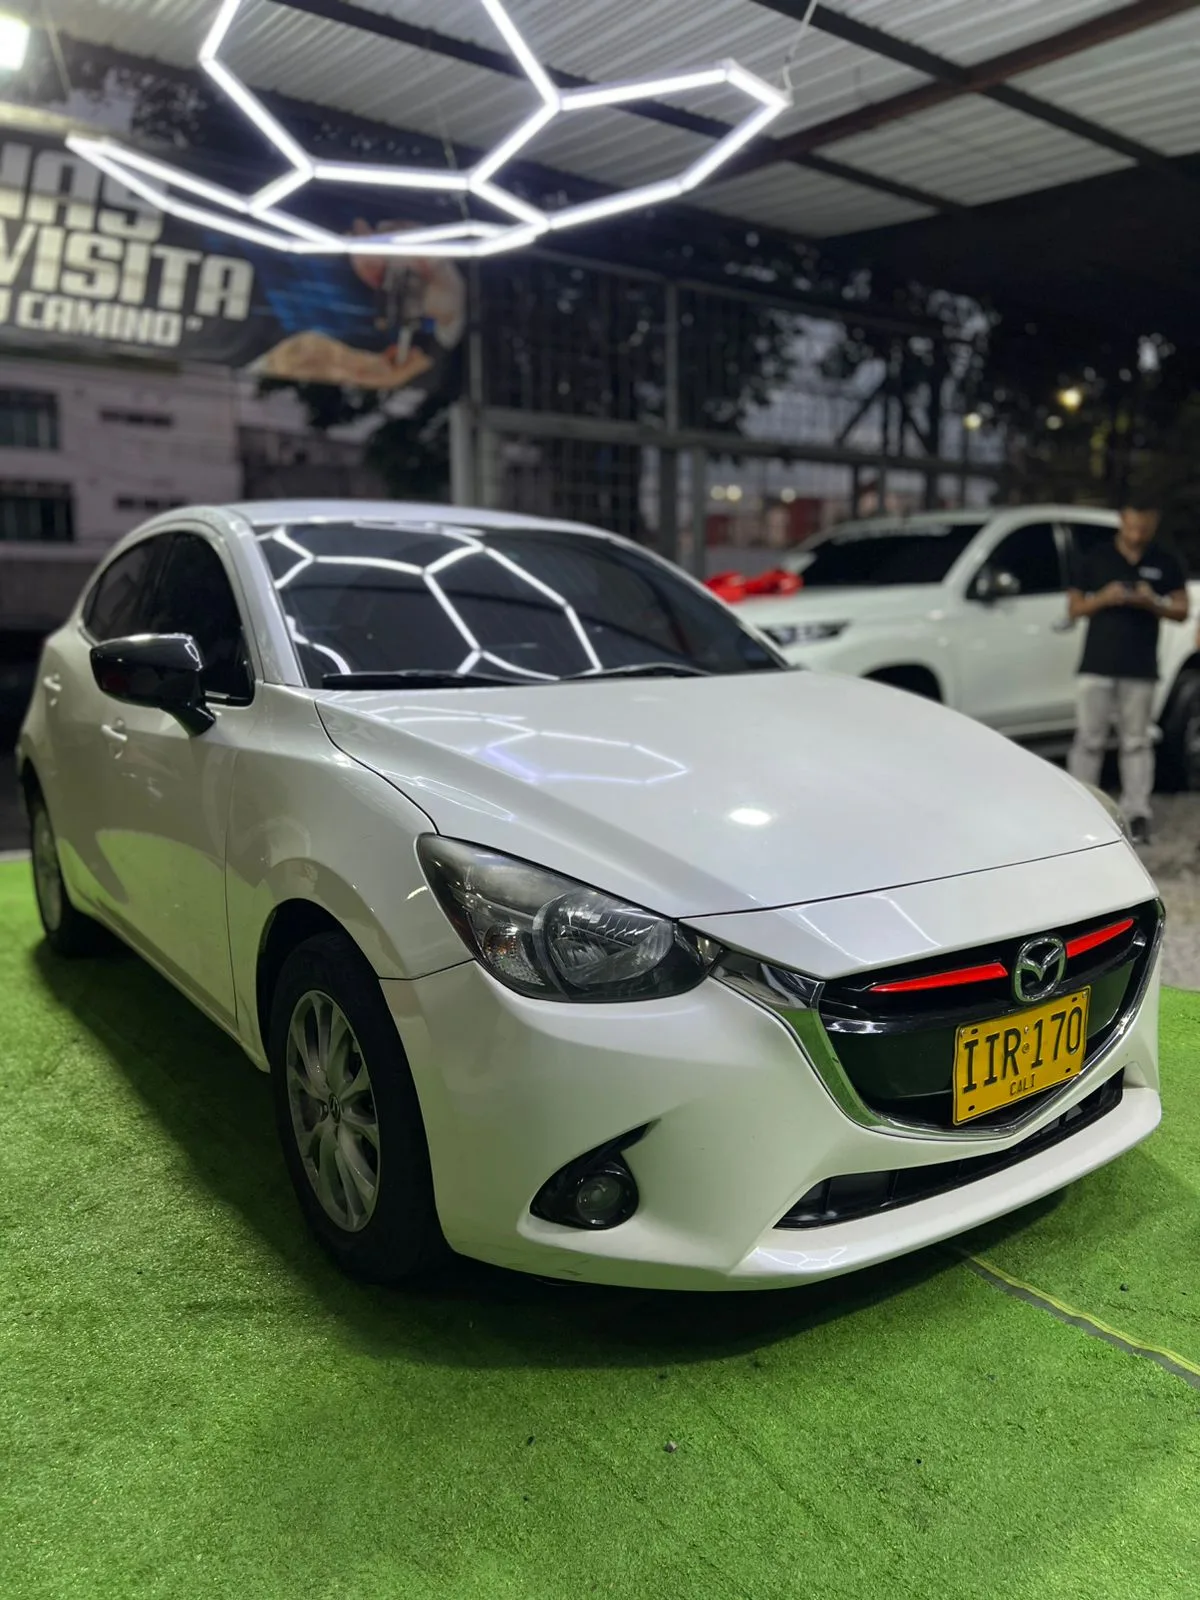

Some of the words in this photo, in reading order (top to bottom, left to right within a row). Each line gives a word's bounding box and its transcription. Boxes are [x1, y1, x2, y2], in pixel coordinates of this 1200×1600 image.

[0, 218, 254, 322] VISITA
[1031, 1006, 1083, 1069] 170
[1009, 1073, 1036, 1097] CALI
